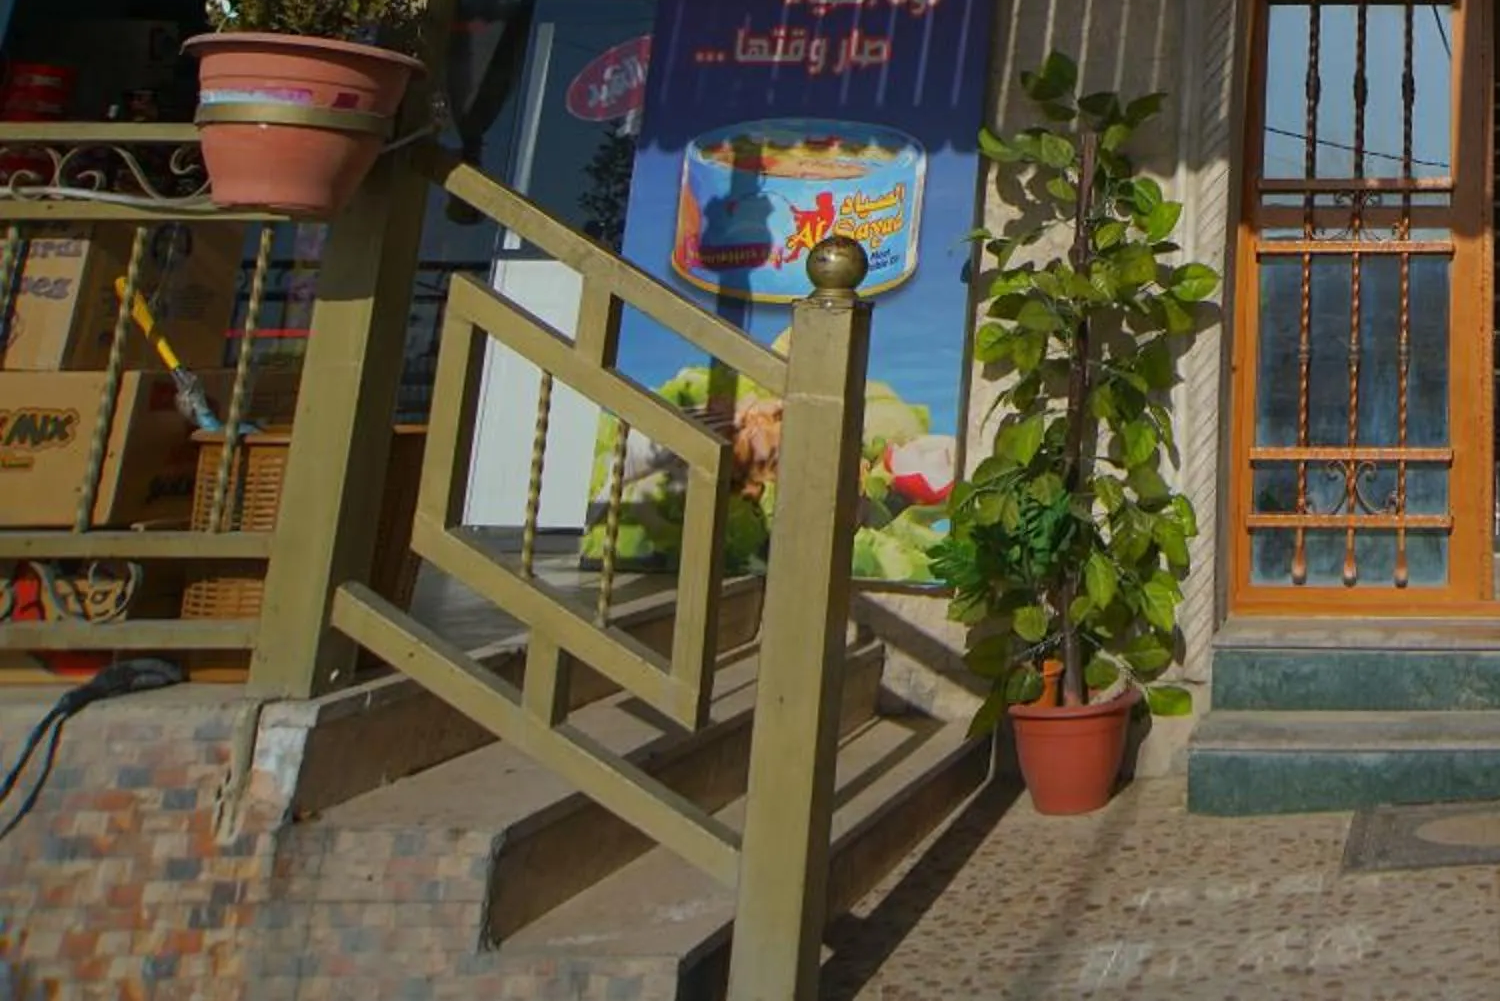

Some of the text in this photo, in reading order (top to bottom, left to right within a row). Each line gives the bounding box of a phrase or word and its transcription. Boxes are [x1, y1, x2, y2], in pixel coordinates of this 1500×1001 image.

[734, 25, 828, 76] وقتها
[832, 26, 892, 75] صار
[785, 215, 828, 251] Al
